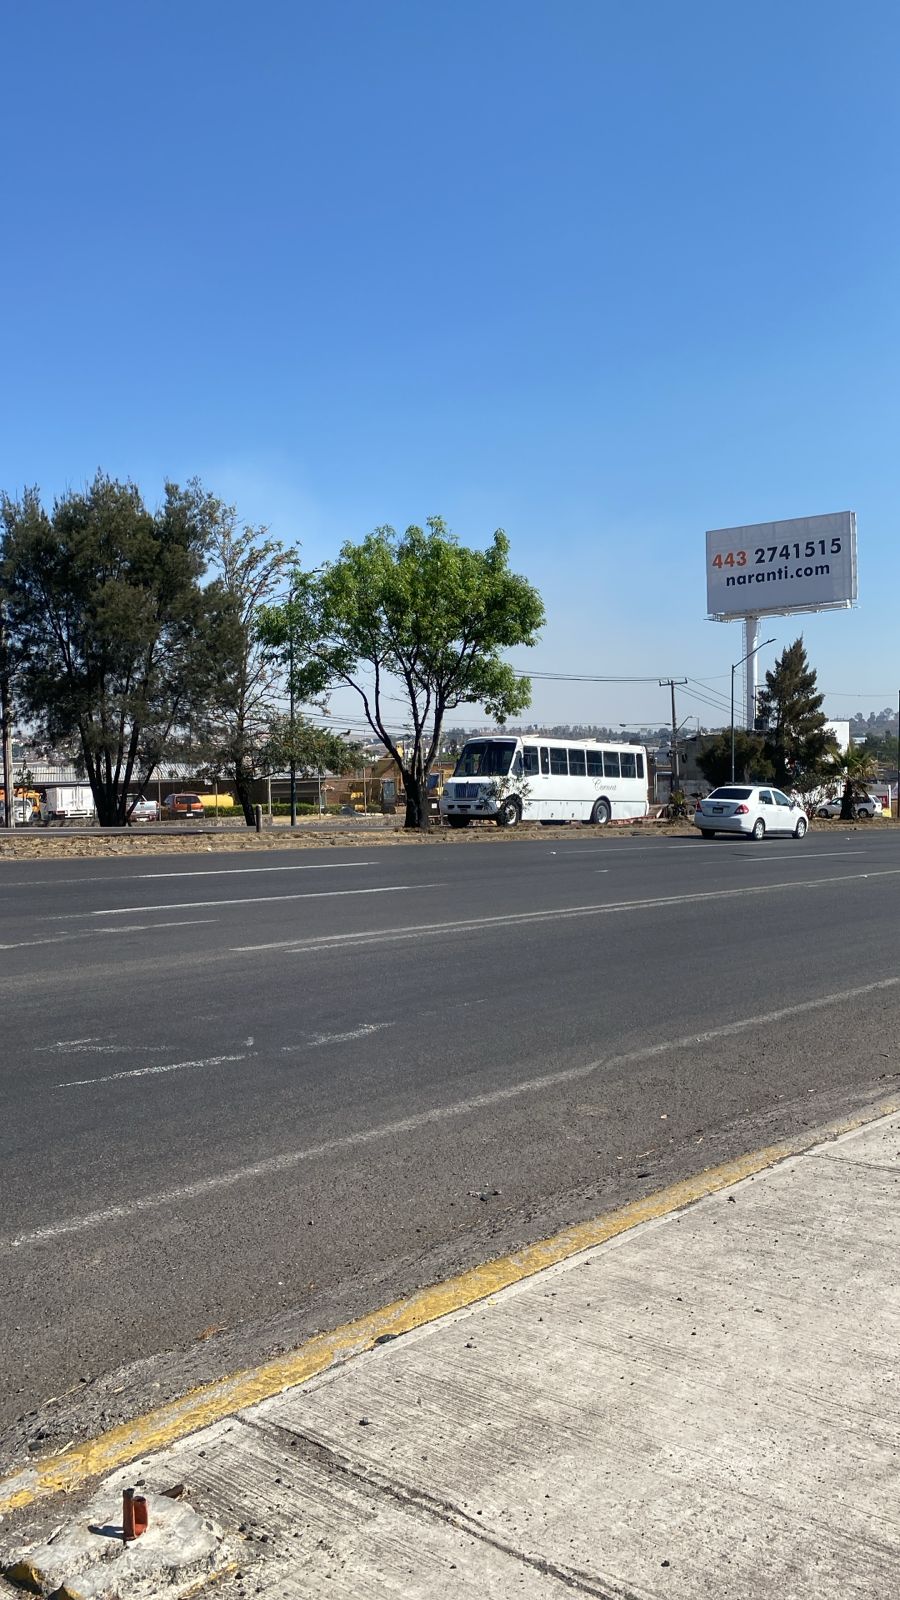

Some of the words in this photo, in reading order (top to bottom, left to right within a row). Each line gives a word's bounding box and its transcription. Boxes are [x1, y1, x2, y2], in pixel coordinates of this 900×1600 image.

[712, 551, 748, 569] 443
[754, 537, 842, 565] 2741515
[726, 564, 830, 587] naranti.com
